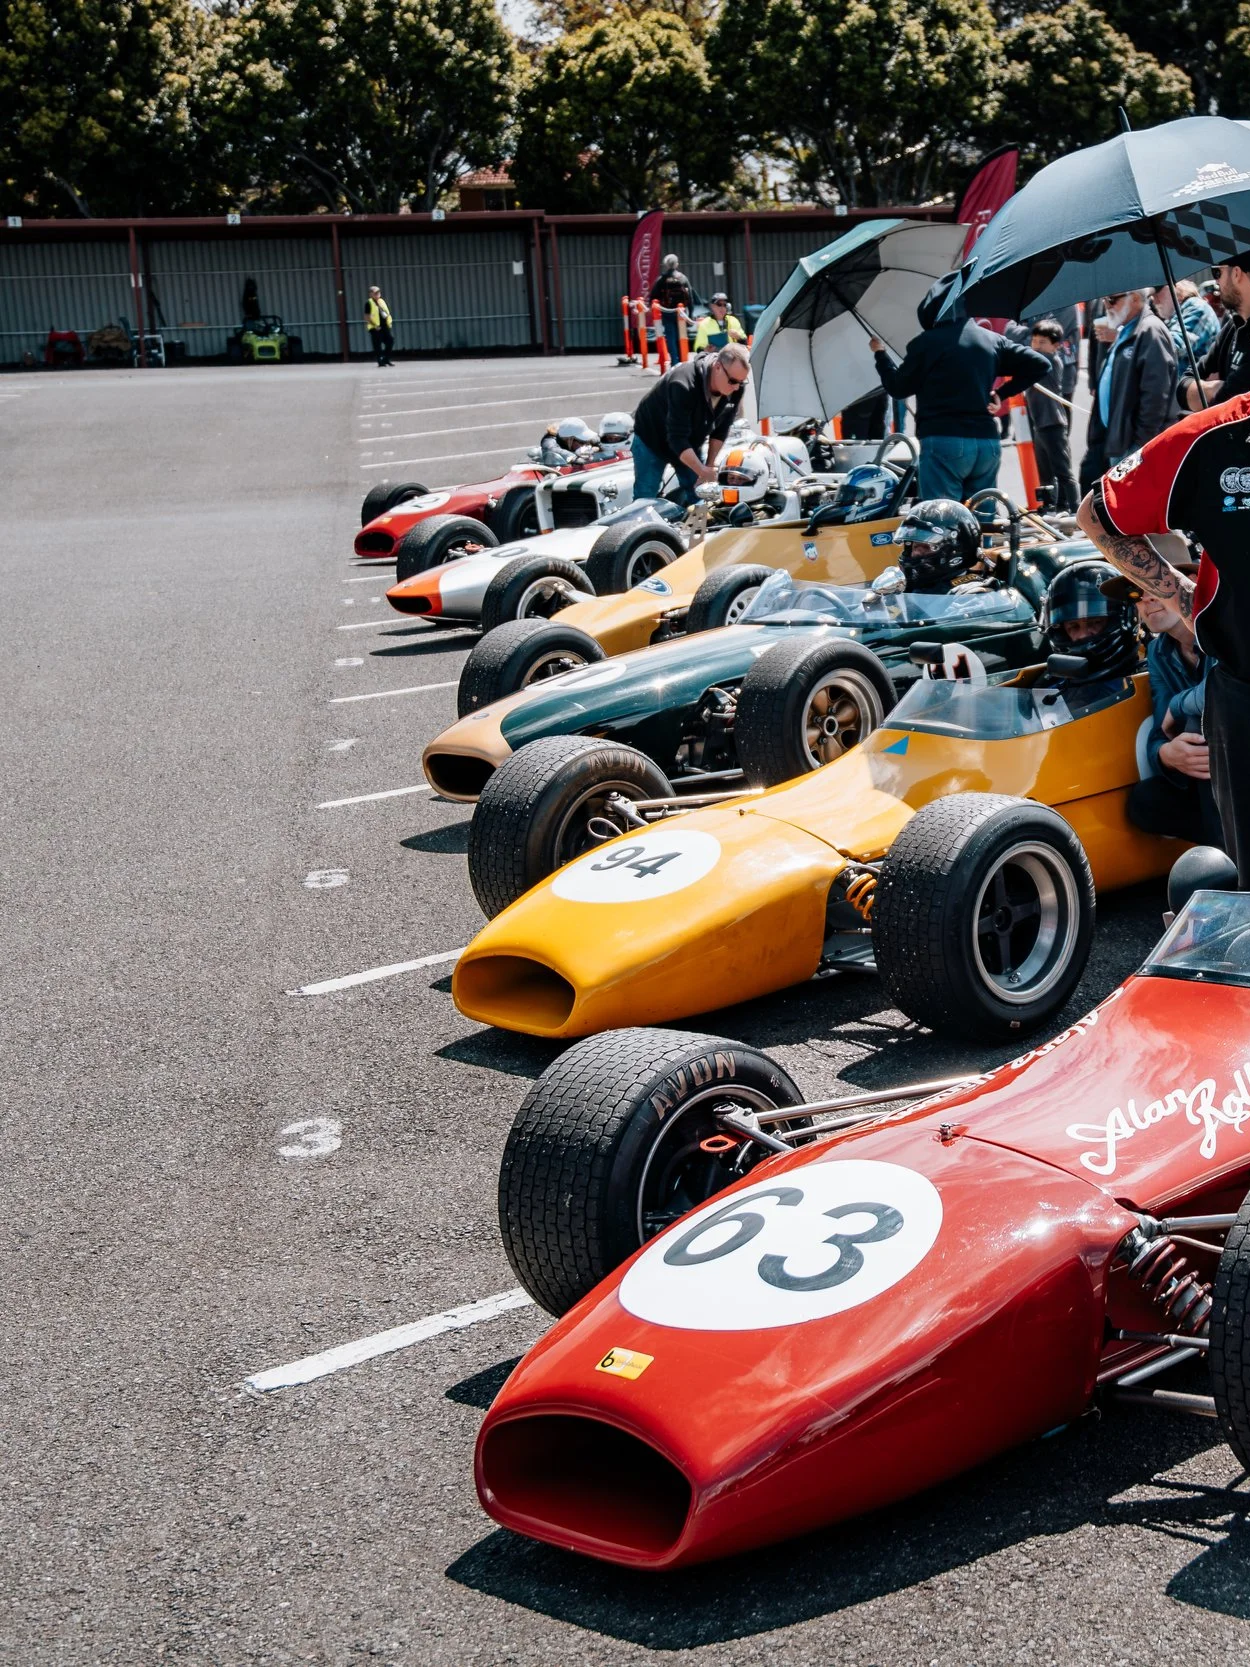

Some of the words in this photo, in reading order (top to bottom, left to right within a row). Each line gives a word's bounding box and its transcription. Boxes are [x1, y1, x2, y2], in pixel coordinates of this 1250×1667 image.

[589, 750, 647, 776] AVON
[302, 867, 350, 890] 5
[590, 846, 683, 879] 94
[650, 1050, 736, 1121] AVON
[277, 1116, 343, 1157] 3
[1065, 1088, 1190, 1176] Alan
[663, 1186, 904, 1292] 63
